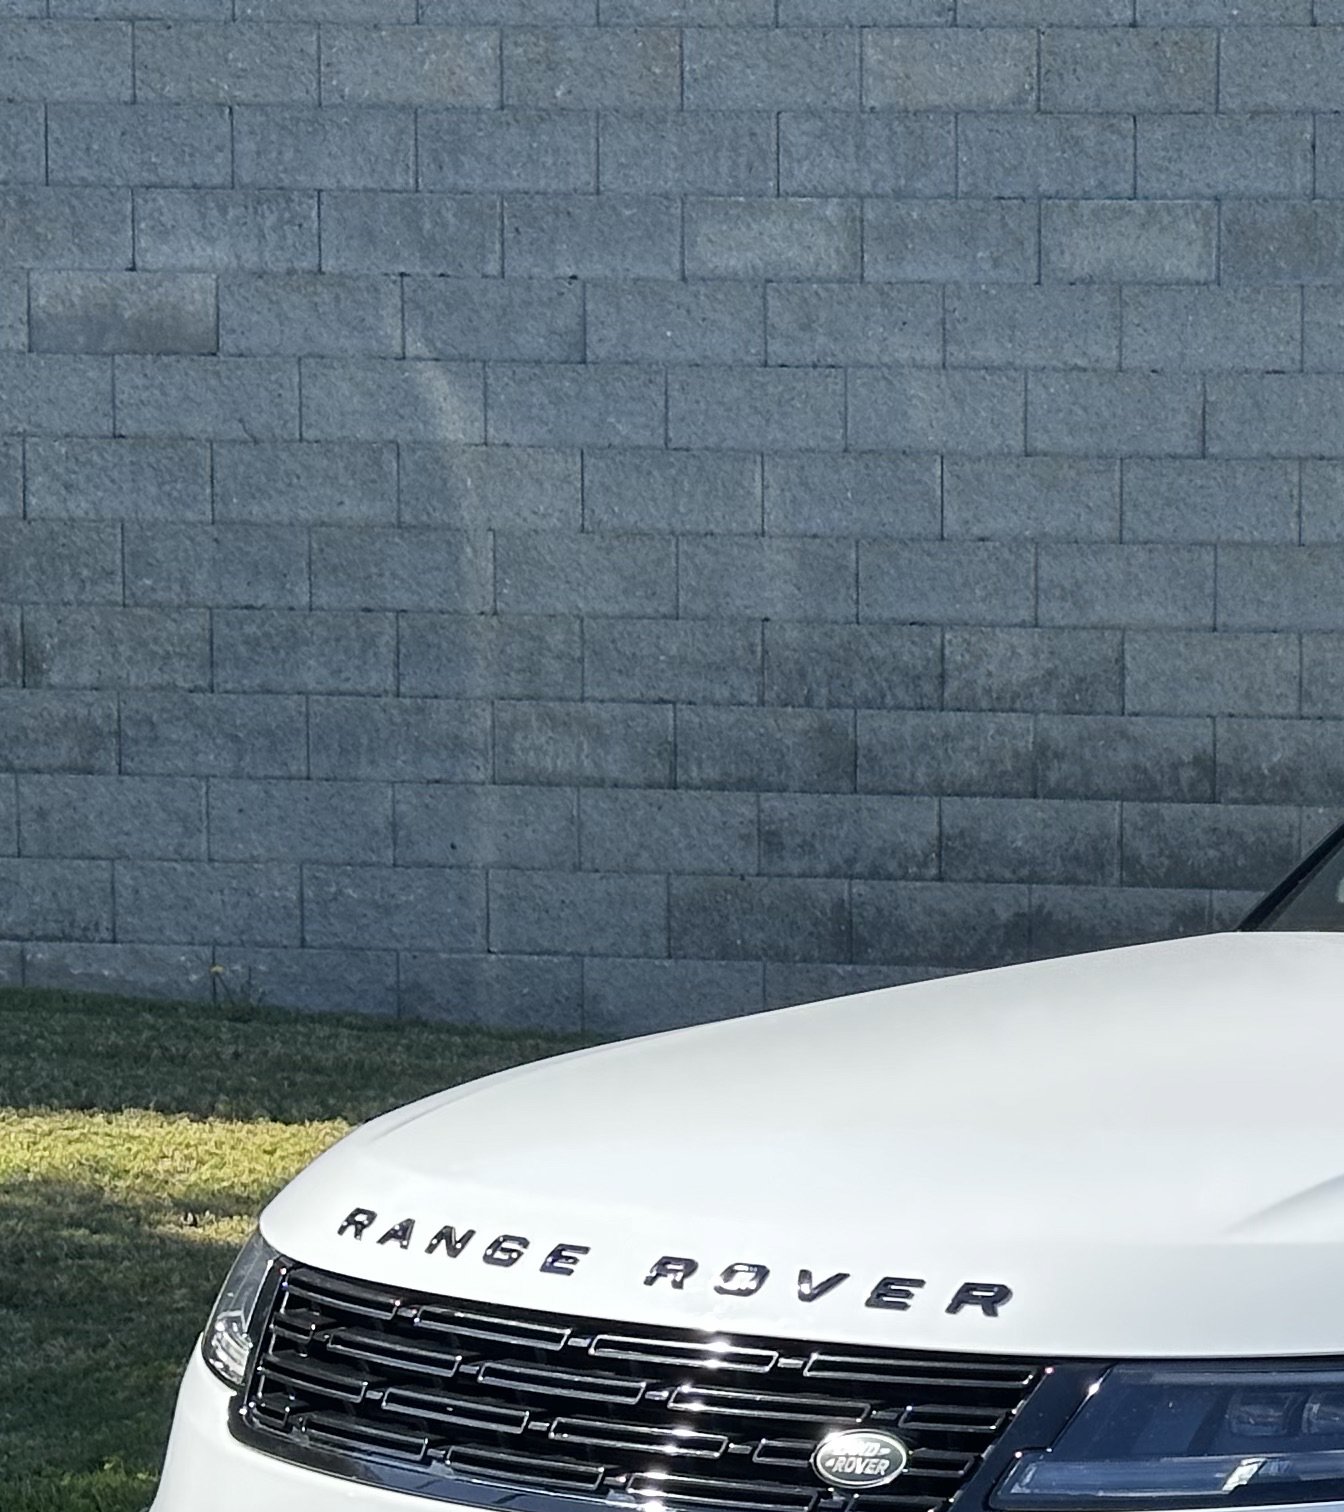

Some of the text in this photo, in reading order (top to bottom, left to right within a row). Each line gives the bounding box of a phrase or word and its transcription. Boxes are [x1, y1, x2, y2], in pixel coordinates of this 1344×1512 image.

[337, 1207, 1013, 1317] RANGE ROVER
[833, 1439, 881, 1456] ND
[832, 1456, 889, 1475] ROVER
